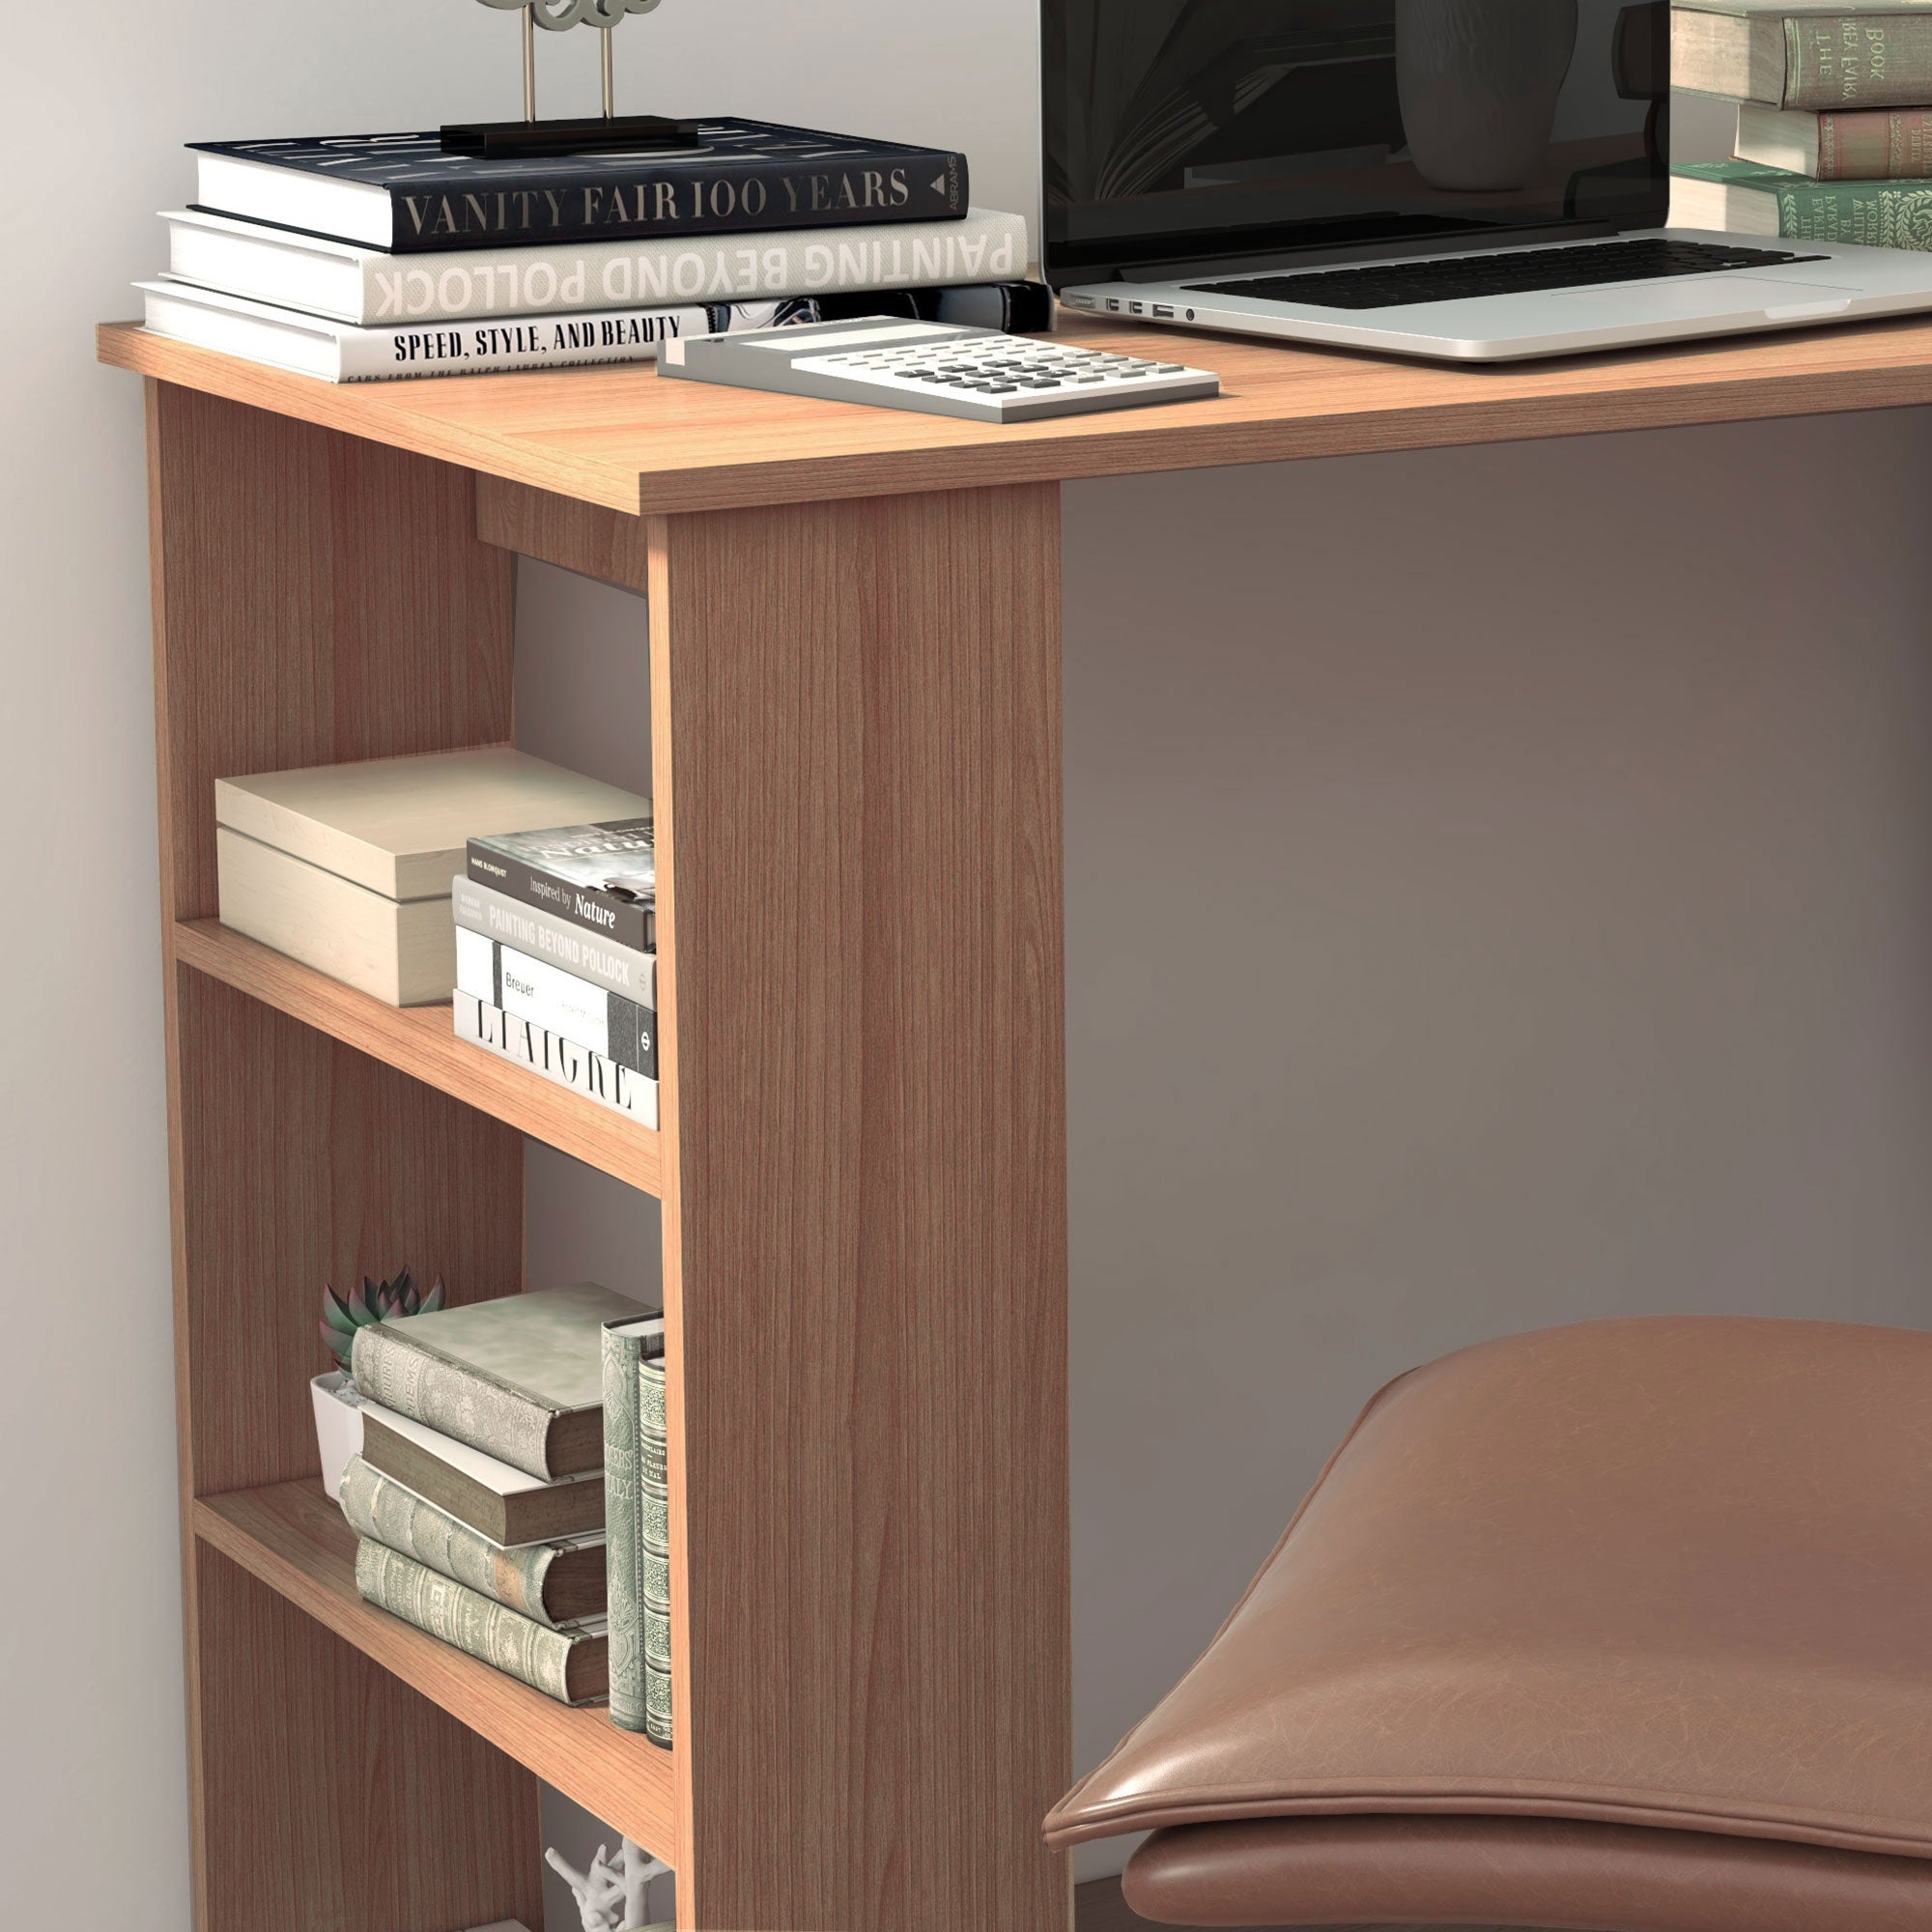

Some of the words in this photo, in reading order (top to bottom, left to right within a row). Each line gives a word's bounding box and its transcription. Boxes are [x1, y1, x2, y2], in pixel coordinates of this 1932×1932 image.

[402, 189, 567, 235] VANITY
[582, 182, 680, 225] FAIR
[779, 168, 909, 213] YEARS
[948, 155, 958, 212] ABRAMS
[603, 247, 787, 300] BEYOND
[805, 233, 1013, 287] PAINTING
[375, 259, 585, 317] POLLOCK
[394, 330, 470, 361] SPEED,
[475, 326, 548, 355] STYLE,
[554, 322, 595, 350] AND
[601, 315, 680, 346] BEAUTY
[540, 838, 655, 859] Natu
[530, 876, 560, 902] Inspired
[561, 889, 572, 909] by
[575, 893, 616, 929] Nature
[489, 905, 535, 946] PAINTING
[538, 924, 580, 964] BEYOND
[582, 945, 630, 986] POLLOCK
[505, 972, 534, 998] Breuer
